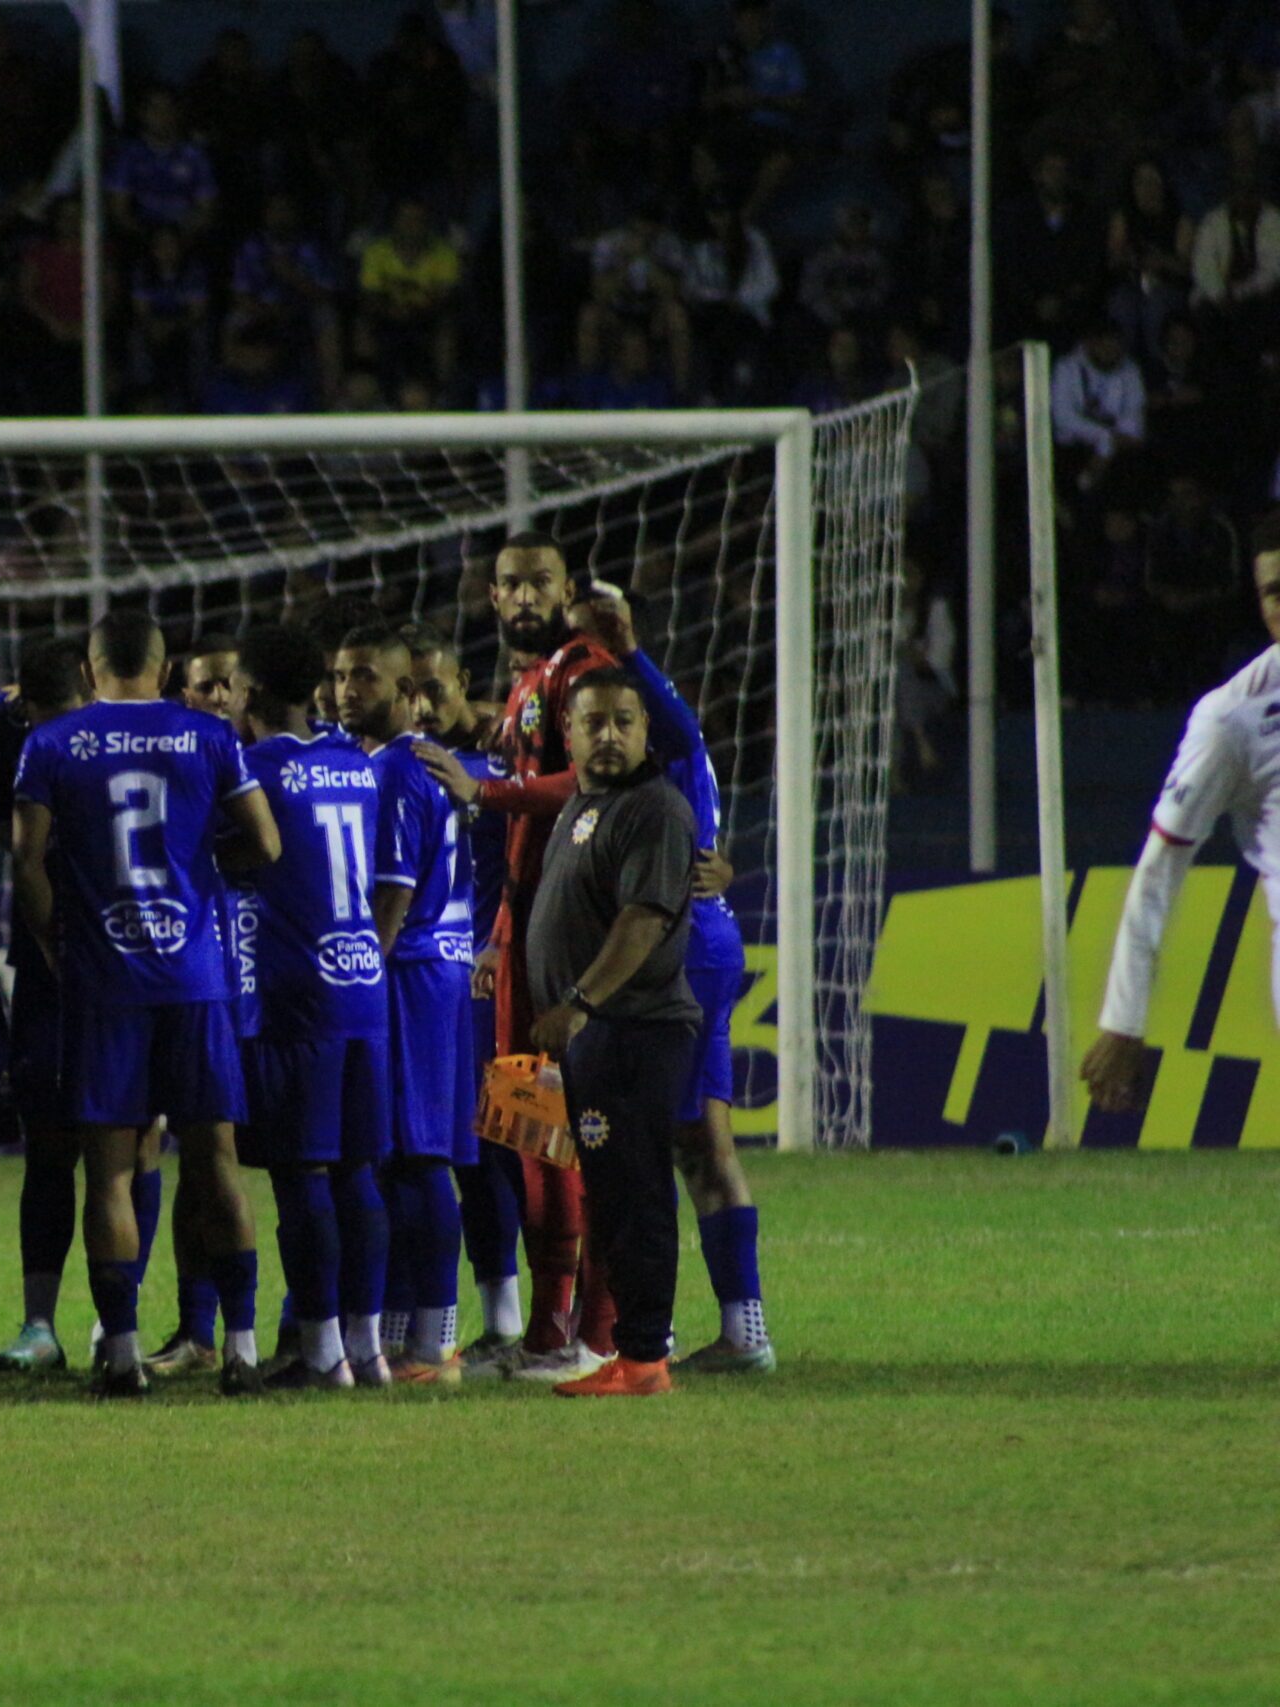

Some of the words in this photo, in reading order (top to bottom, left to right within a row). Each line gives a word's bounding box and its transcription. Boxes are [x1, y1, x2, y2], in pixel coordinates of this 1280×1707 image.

[105, 731, 198, 754] Sicredi
[311, 765, 377, 789] Sicredi
[108, 769, 168, 888] 2
[313, 803, 372, 922] 11
[105, 914, 186, 940] Conde
[318, 946, 380, 972] Conde
